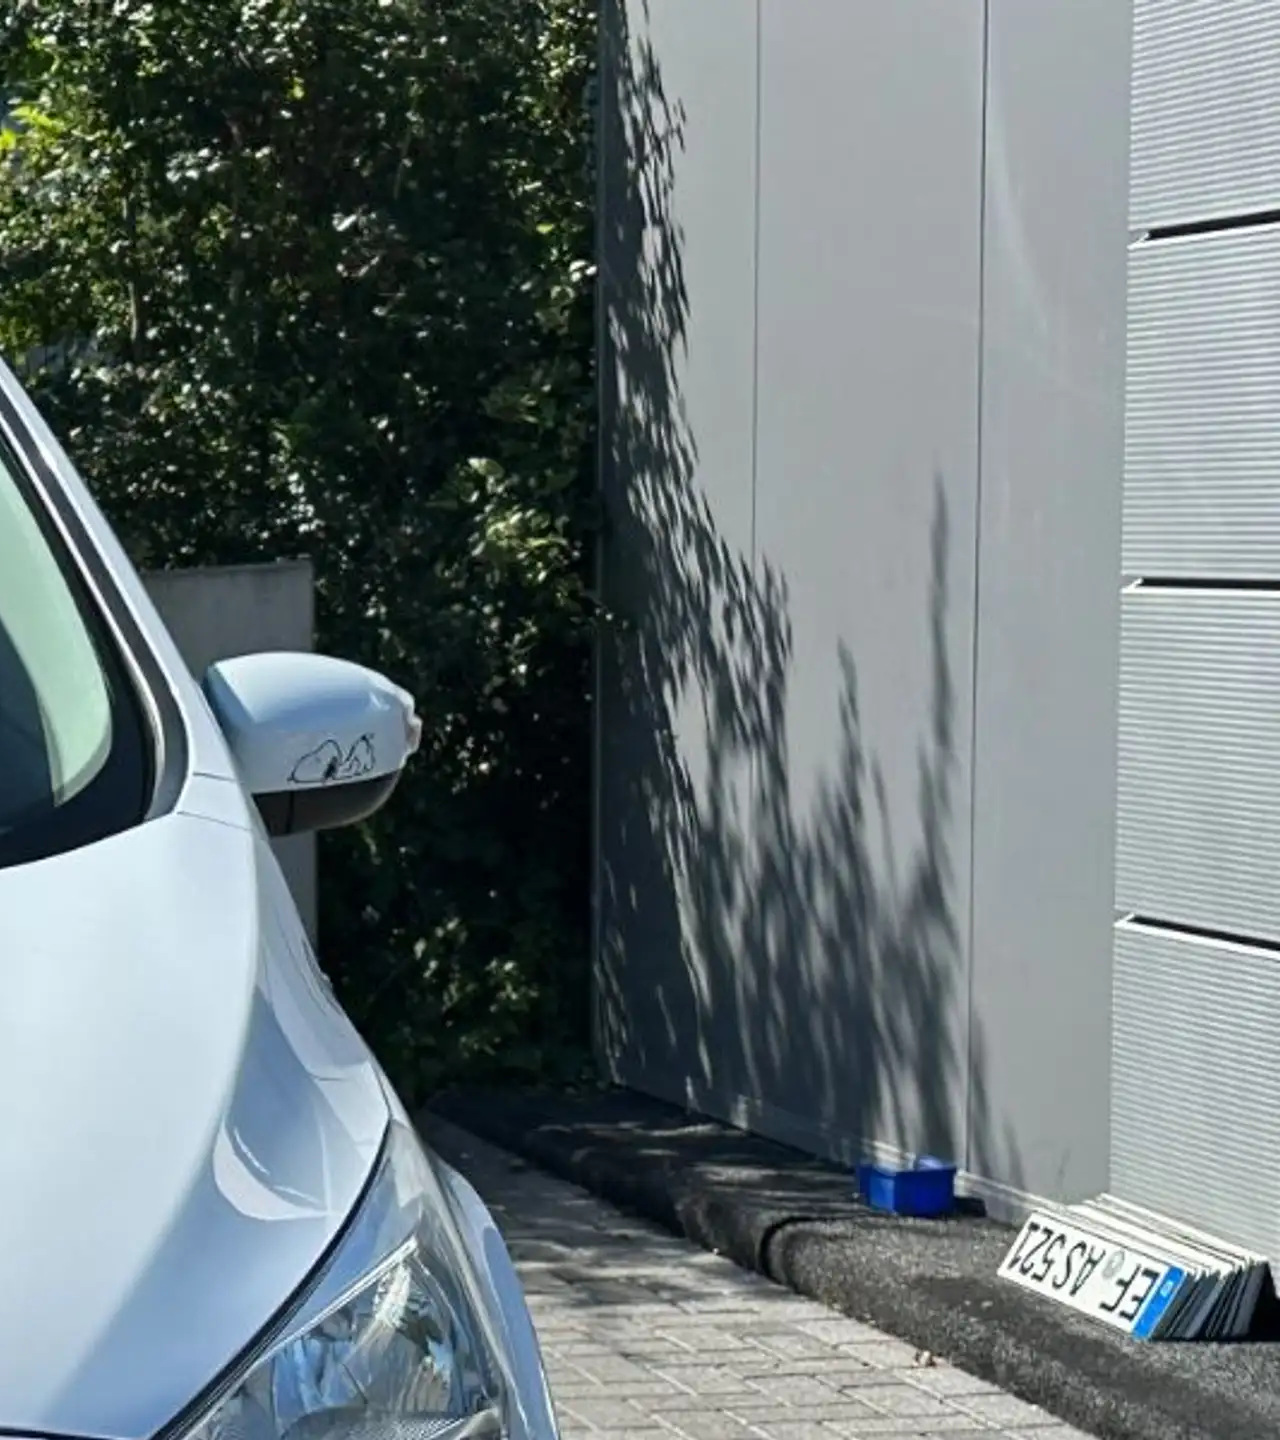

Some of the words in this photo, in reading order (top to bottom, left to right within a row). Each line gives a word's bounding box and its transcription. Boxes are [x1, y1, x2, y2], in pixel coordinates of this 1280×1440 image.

[1007, 1221, 1066, 1282] 521
[1052, 1240, 1108, 1297] AS
[1099, 1264, 1161, 1321] EF
